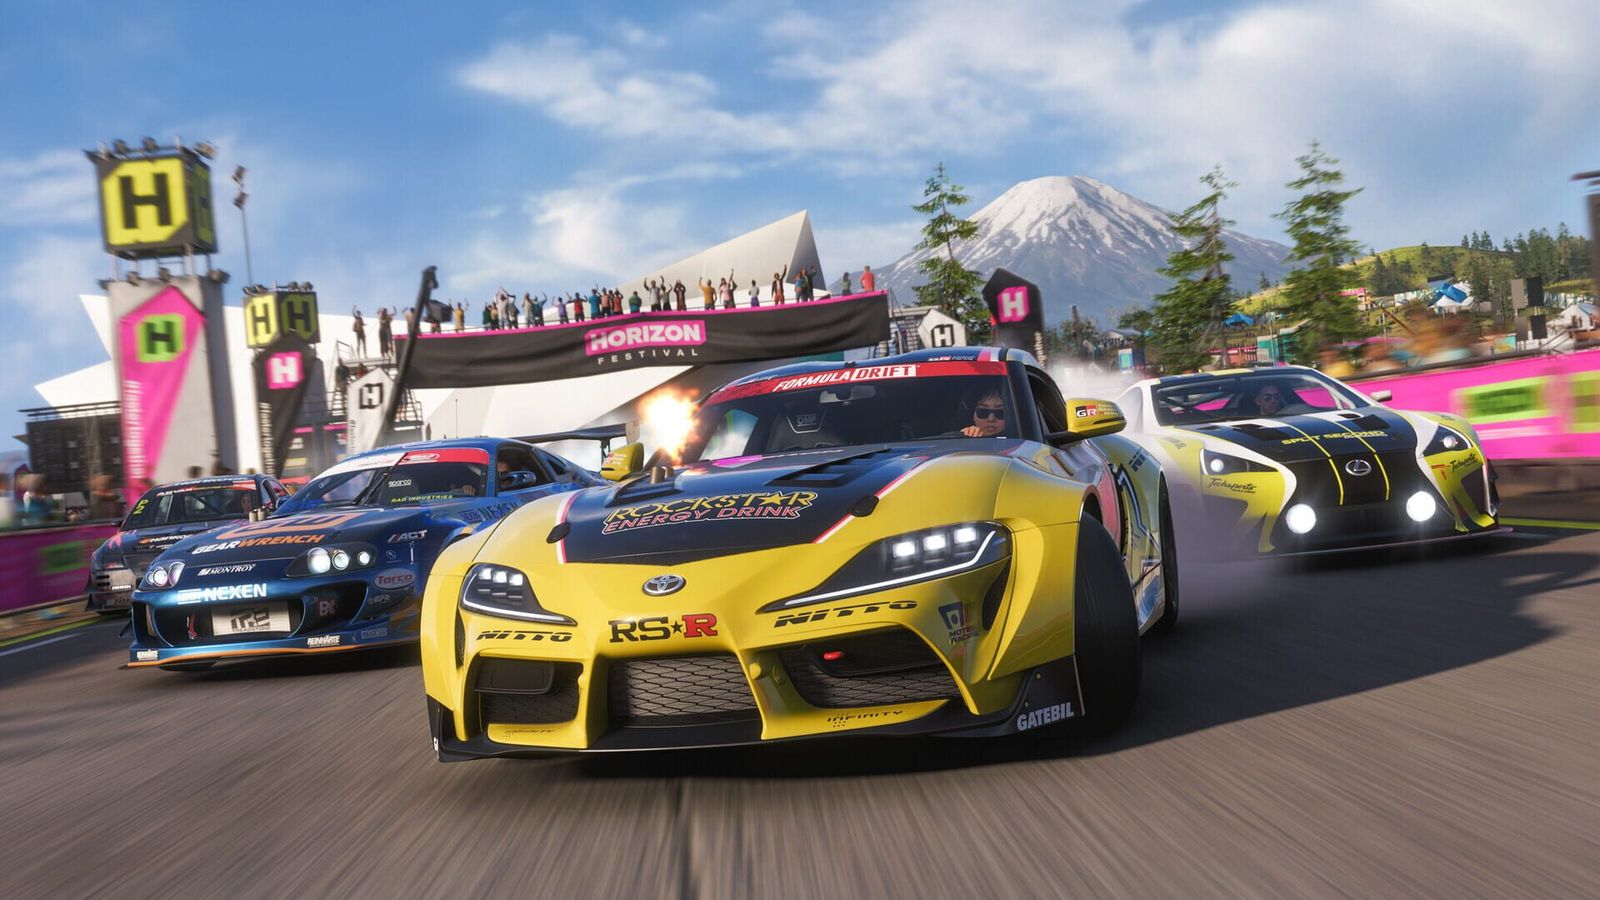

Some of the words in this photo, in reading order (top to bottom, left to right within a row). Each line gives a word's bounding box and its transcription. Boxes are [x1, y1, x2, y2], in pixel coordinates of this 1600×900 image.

[118, 171, 173, 229] H
[286, 300, 313, 333] H
[1001, 290, 1024, 318] H
[250, 302, 273, 335] H
[144, 319, 178, 356] H
[591, 324, 701, 352] HORIZON
[270, 355, 301, 385] H
[597, 348, 699, 365] FESTIVAL
[773, 370, 849, 392] FORMULA
[855, 365, 915, 379] DRIFT
[1076, 407, 1097, 418] GR
[1281, 435, 1320, 445] SPLIT
[388, 479, 411, 487] sparco
[408, 494, 453, 502] INDUSTRIES
[603, 507, 714, 536] ENERGY
[717, 504, 803, 521] DRINK
[192, 534, 326, 554] GEARWRENCH
[209, 564, 257, 575] MONTROY
[377, 574, 413, 585] Torco
[204, 583, 267, 602] NEXEN
[774, 600, 918, 628] NITTO
[476, 630, 573, 643] NITTO
[1016, 702, 1074, 731] GATEBIL
